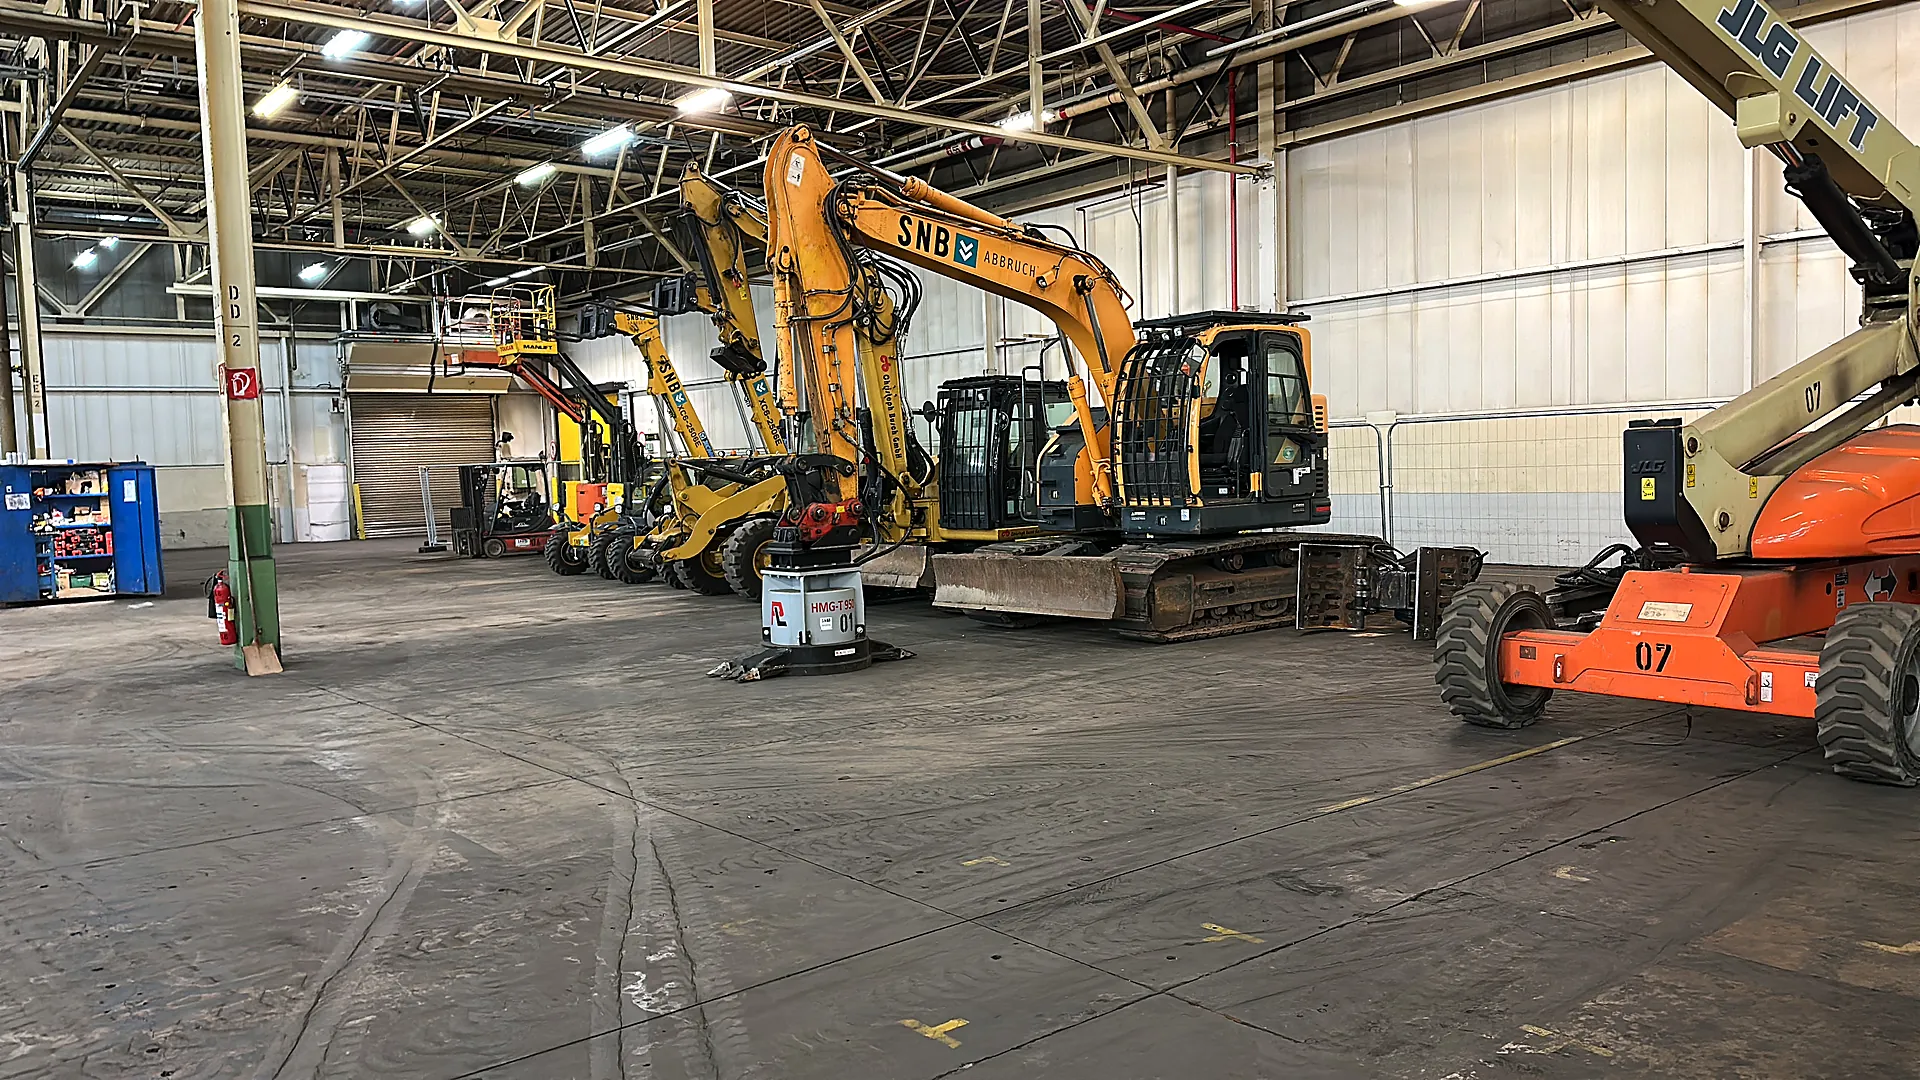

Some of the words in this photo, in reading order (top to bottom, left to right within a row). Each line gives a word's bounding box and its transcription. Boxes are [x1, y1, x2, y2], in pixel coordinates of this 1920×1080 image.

[1716, 0, 1799, 80] JLG
[1794, 54, 1878, 150] LIFT
[898, 214, 950, 257] SNB
[984, 250, 1036, 278] ABBRUCH
[232, 334, 241, 347] 2
[659, 361, 681, 393] SNB
[1805, 381, 1820, 413] 07
[1631, 460, 1666, 475] JLG
[811, 601, 843, 613] HMG-T
[840, 612, 853, 633] 01
[1635, 641, 1672, 673] 07
